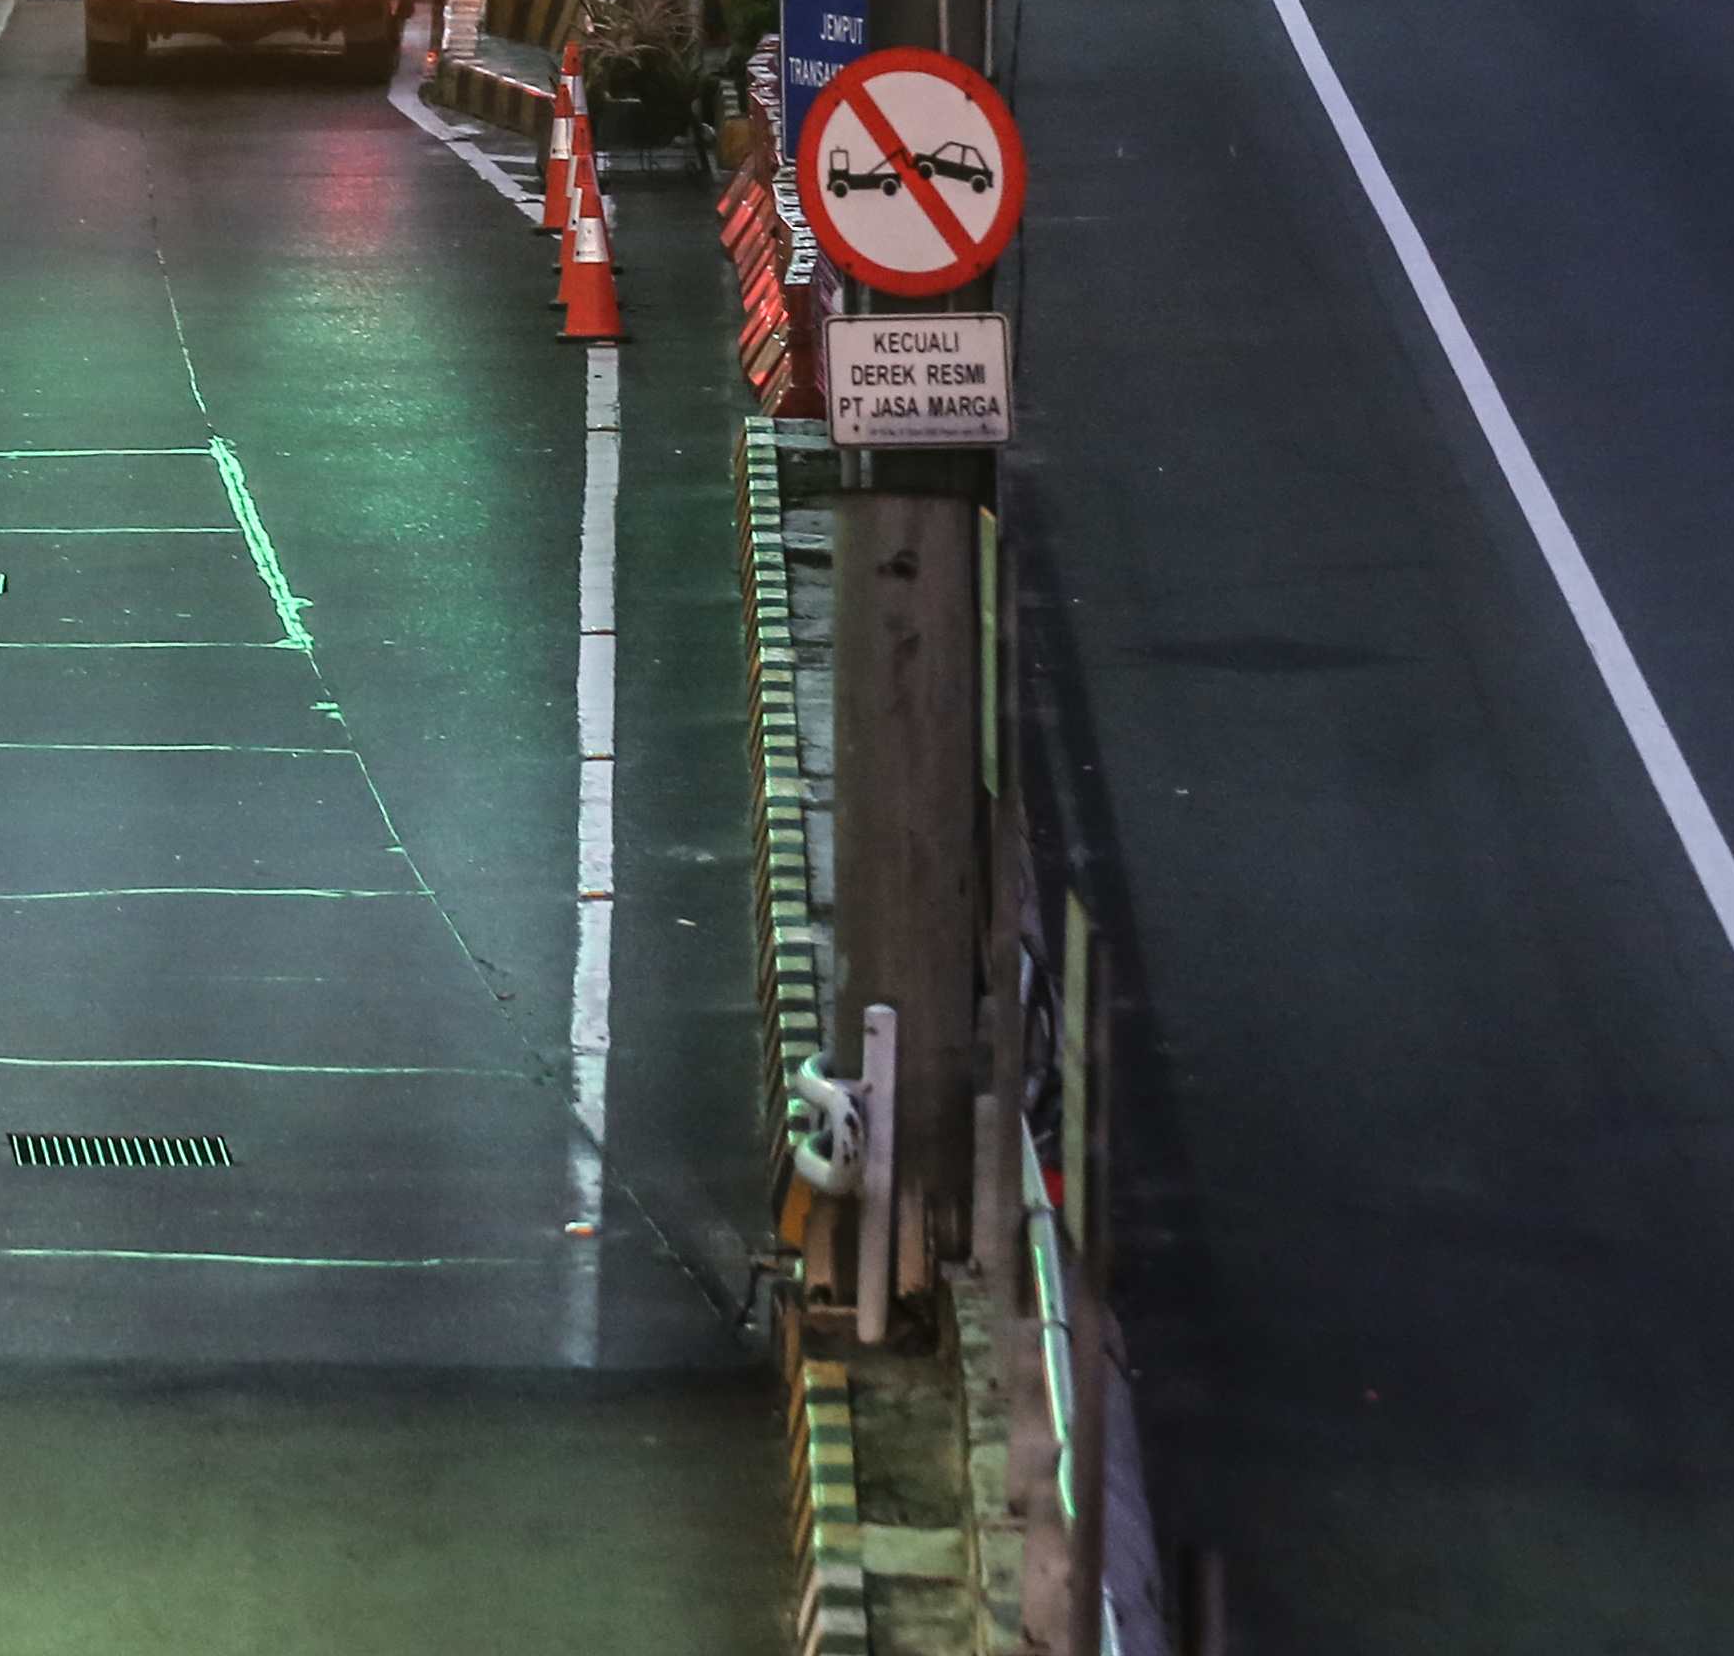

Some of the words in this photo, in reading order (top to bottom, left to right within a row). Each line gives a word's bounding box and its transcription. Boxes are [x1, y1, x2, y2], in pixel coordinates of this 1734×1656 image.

[820, 12, 864, 45] JEMPUT
[874, 332, 959, 354] KECUALI
[851, 364, 916, 386] DEREK
[927, 364, 986, 385] RESMI
[840, 397, 863, 418] PT
[871, 396, 920, 418] JASA
[928, 396, 1000, 418] MARGA
